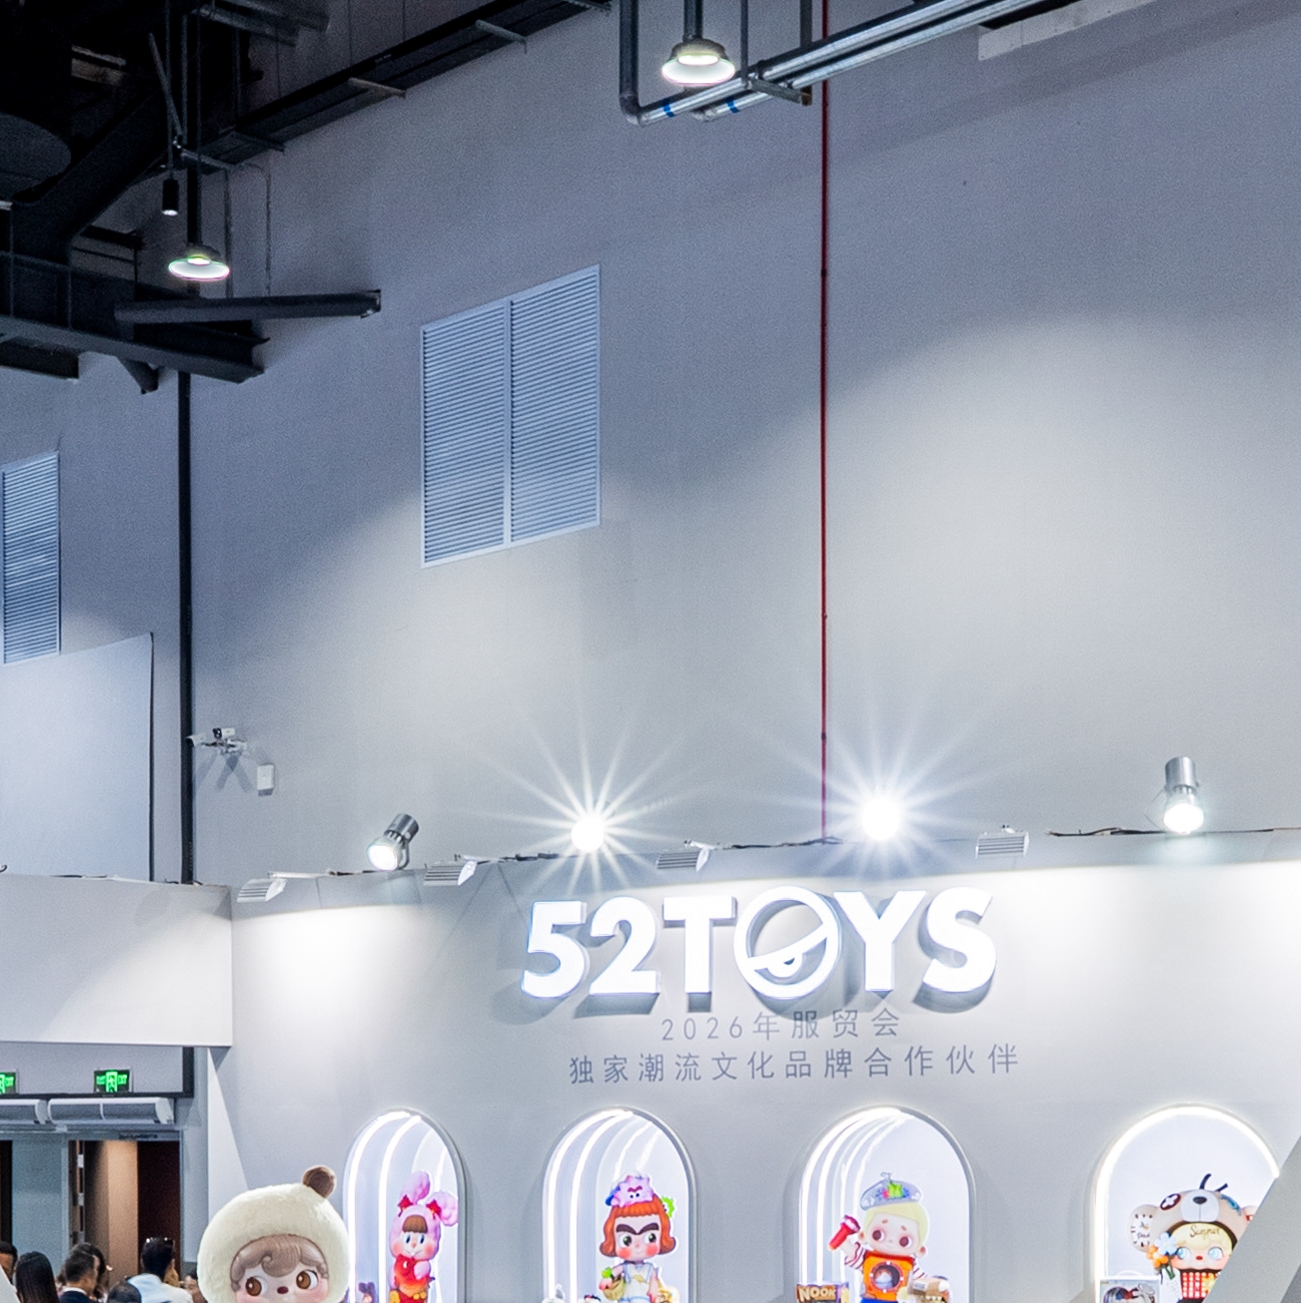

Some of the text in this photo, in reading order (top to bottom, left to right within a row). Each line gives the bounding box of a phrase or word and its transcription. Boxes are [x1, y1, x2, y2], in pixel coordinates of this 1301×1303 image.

[520, 885, 997, 1000] 52TOYS
[661, 1007, 900, 1041] 2026年服贸会
[569, 1043, 1019, 1086] 独家潮流文化品牌合作伙伴
[799, 1286, 836, 1302] NOOK
